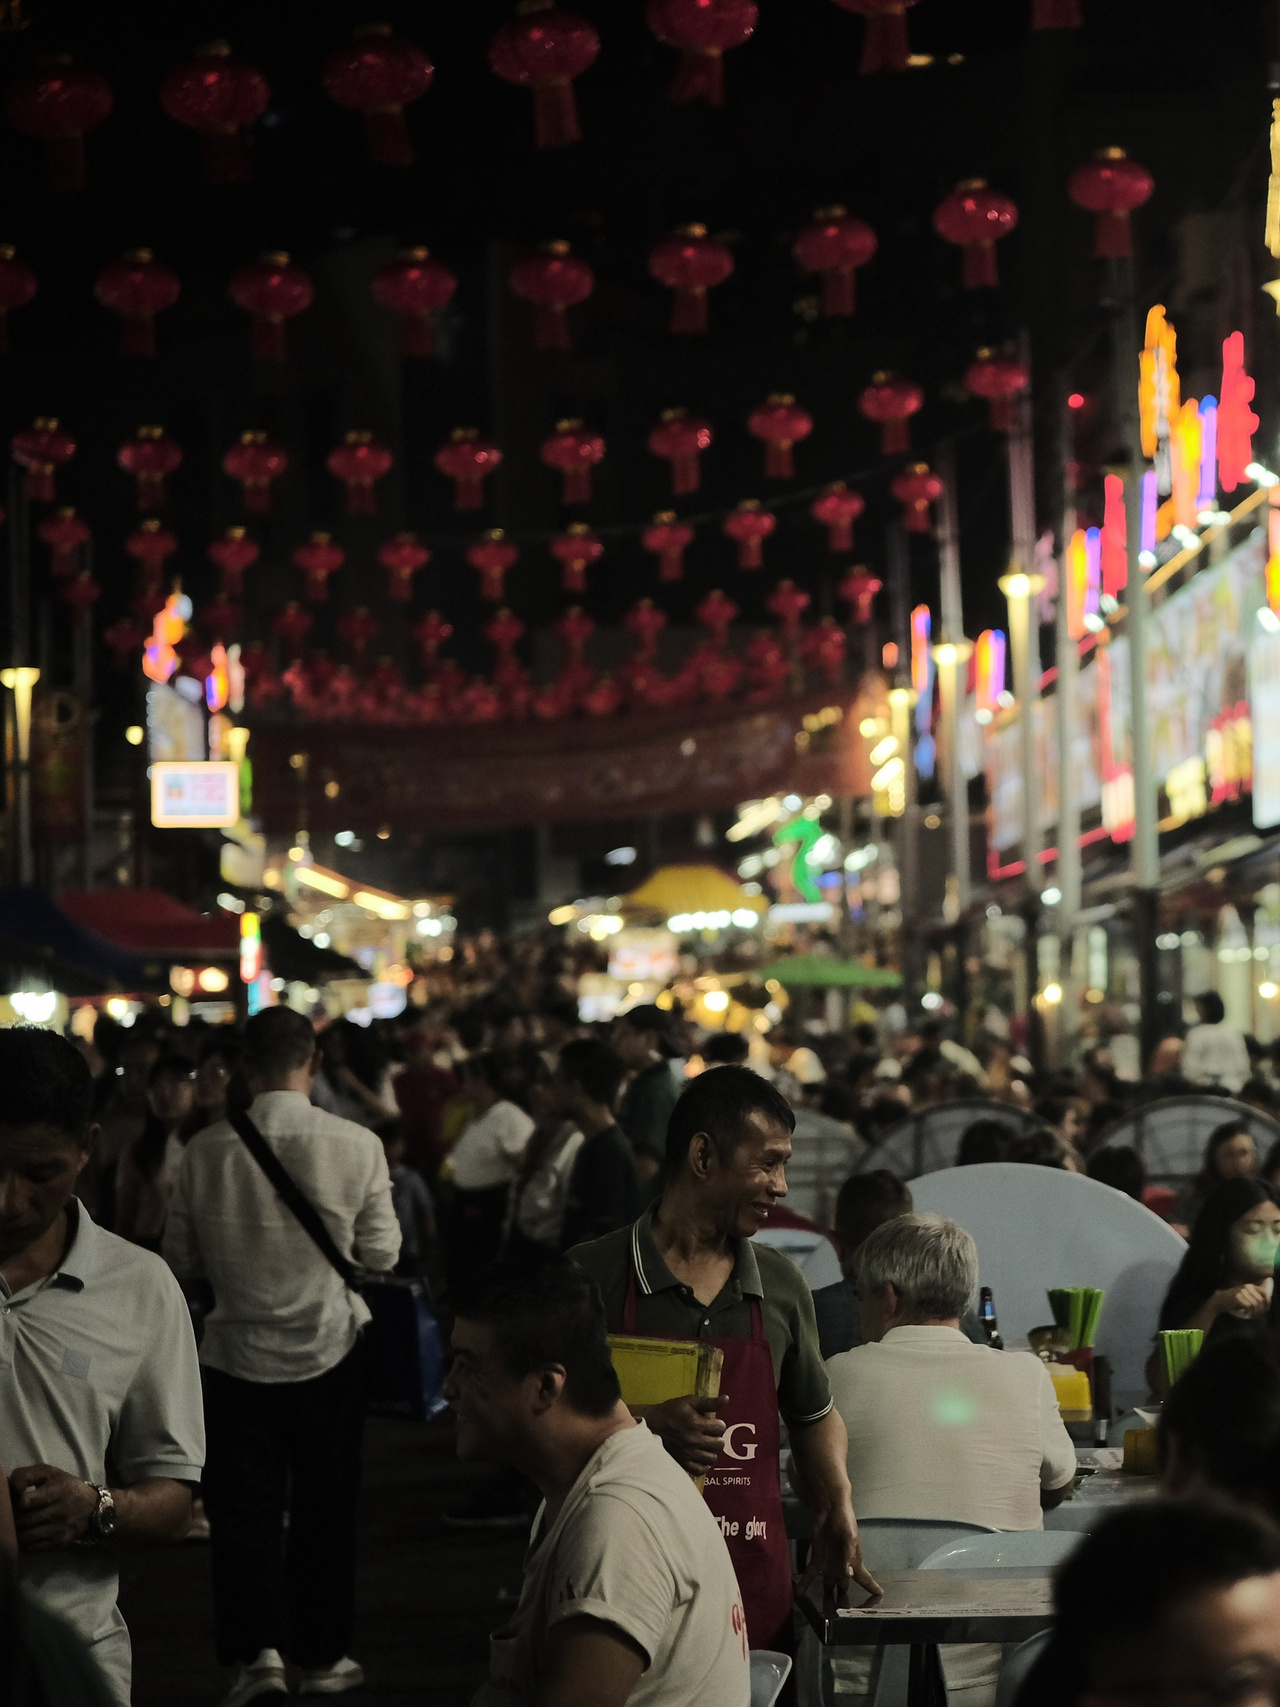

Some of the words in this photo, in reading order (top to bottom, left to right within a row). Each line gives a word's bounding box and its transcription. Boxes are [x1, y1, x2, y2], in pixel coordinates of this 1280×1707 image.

[722, 1423, 758, 1460] G
[704, 1477, 721, 1485] BAL
[722, 1476, 751, 1486] SPIRITS
